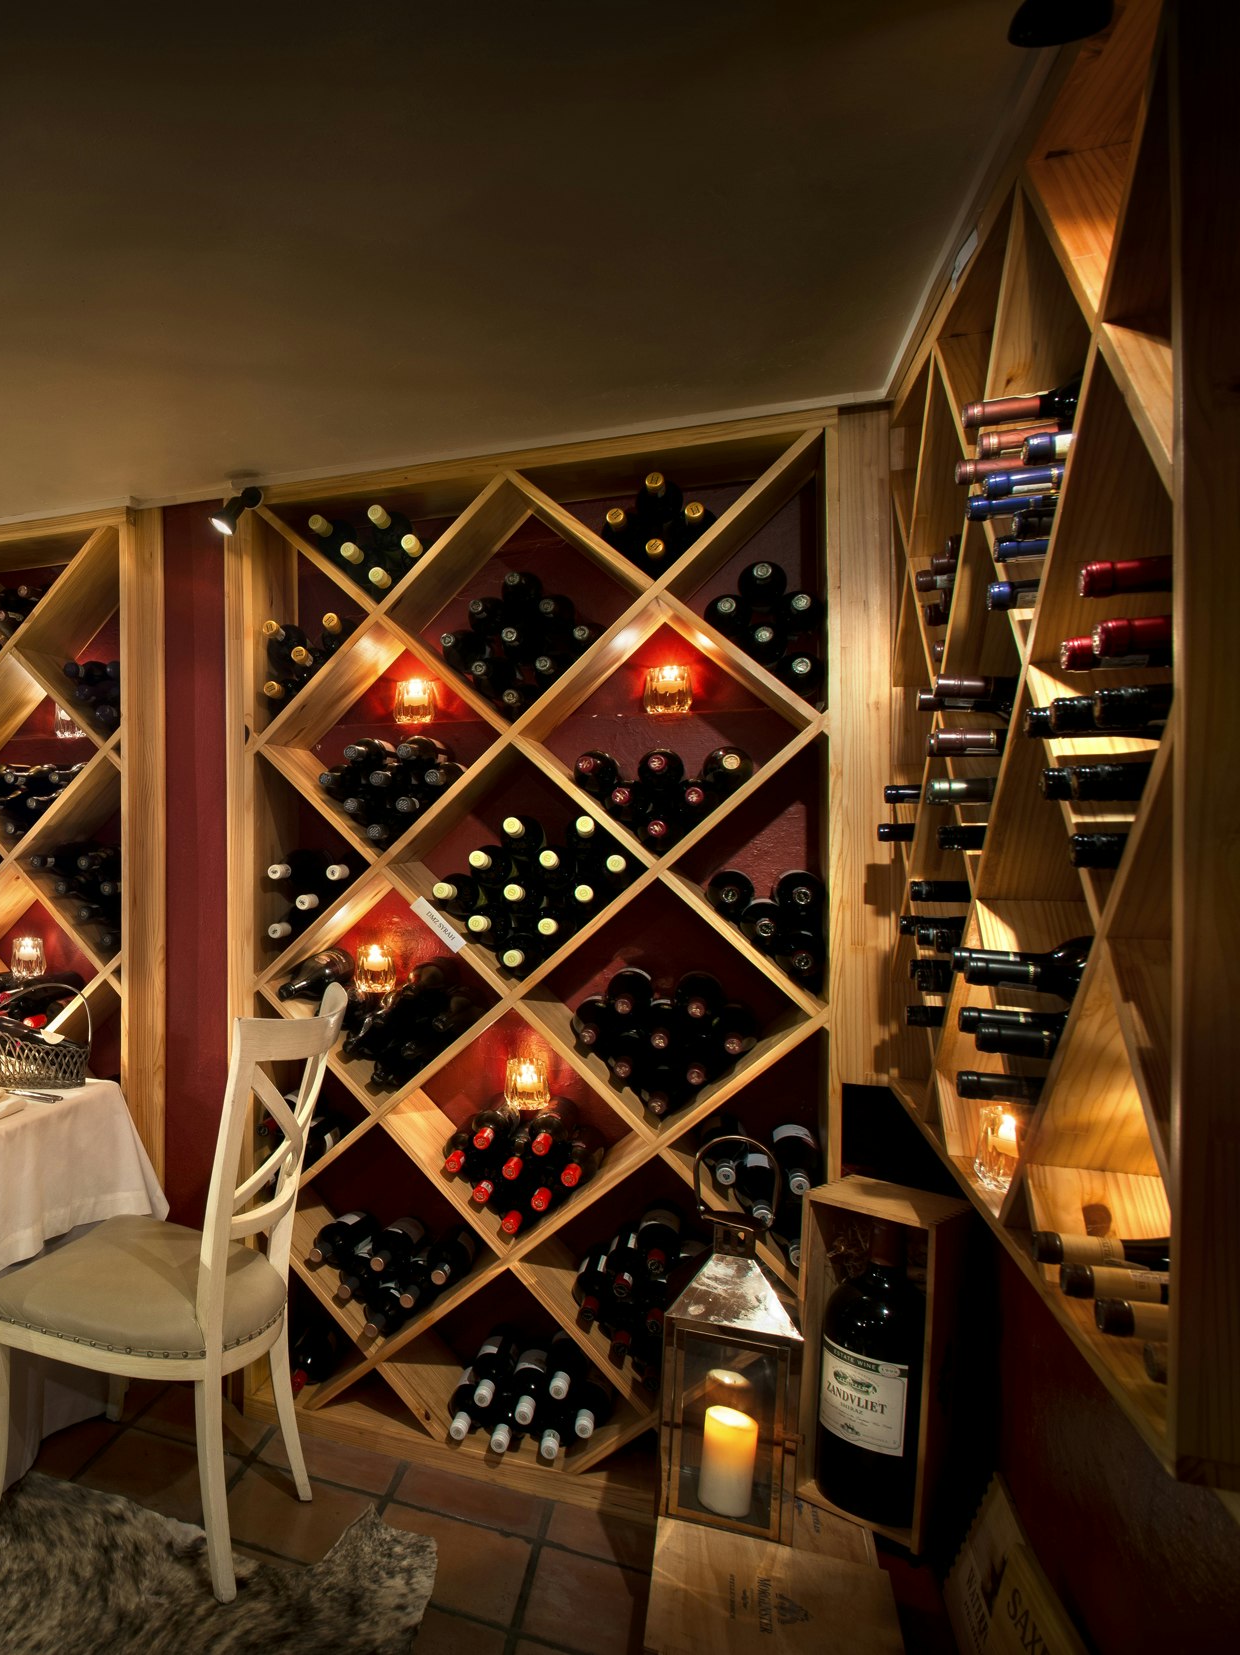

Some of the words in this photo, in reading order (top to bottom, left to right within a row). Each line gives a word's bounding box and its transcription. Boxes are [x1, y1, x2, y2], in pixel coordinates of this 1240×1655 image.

[426, 911, 440, 925] DMZ
[438, 922, 456, 941] SYRAH
[833, 1348, 856, 1364] ESTATE
[858, 1360, 877, 1370] WINE
[826, 1380, 888, 1415] ZANDVLIET
